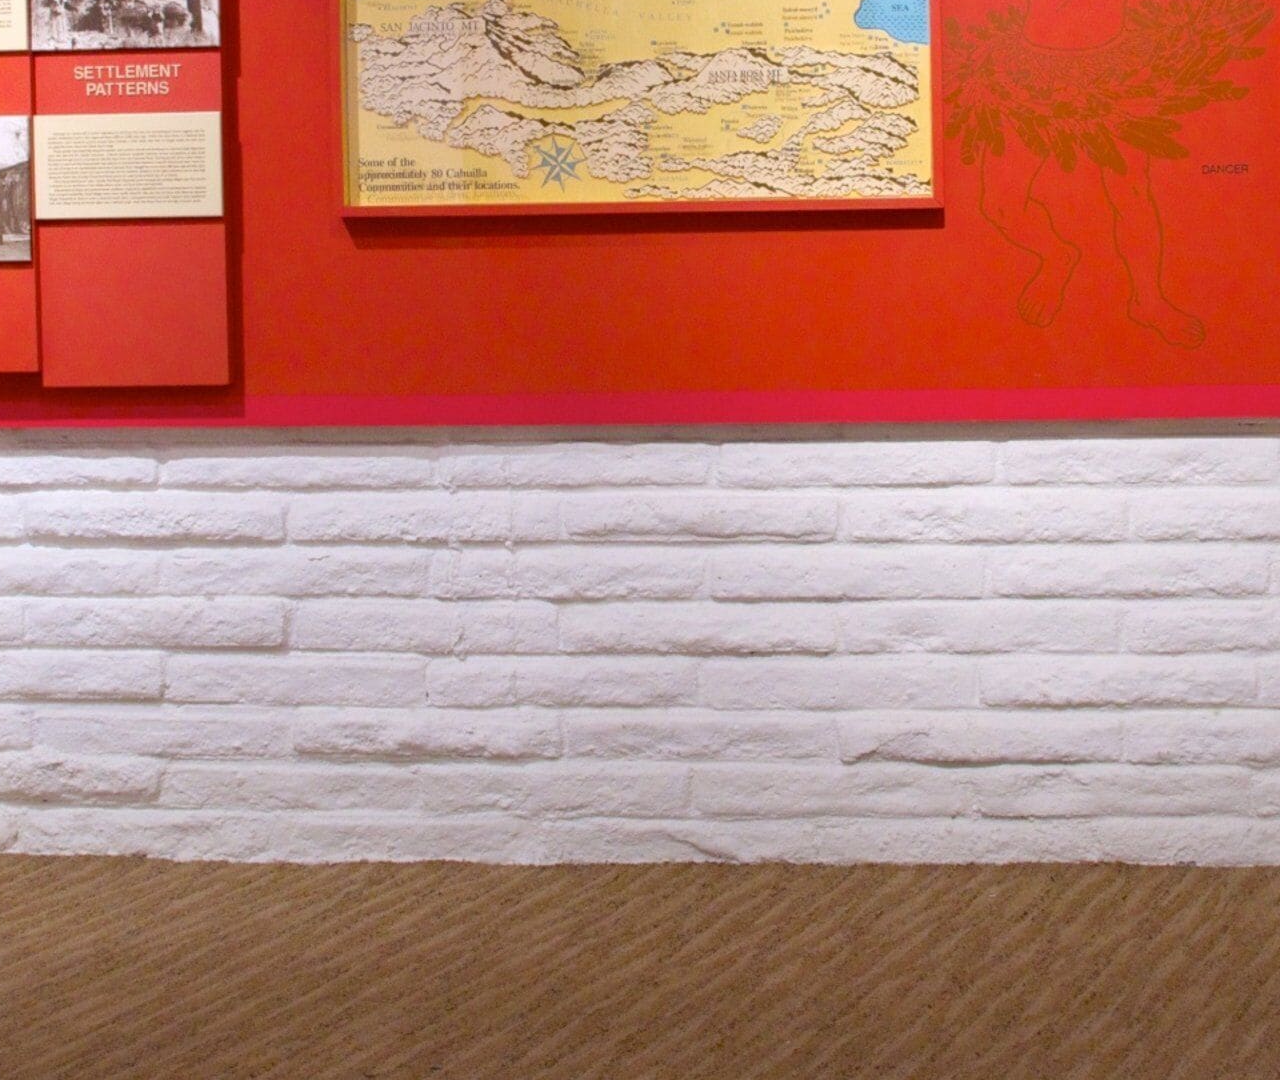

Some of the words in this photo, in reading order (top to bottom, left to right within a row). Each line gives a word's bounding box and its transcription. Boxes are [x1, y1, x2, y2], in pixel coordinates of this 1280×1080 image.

[891, 4, 909, 12] SEA
[73, 64, 181, 80] SETTLEMENT
[86, 81, 170, 97] PATTERNS
[358, 158, 384, 167] Some
[388, 158, 396, 166] of
[400, 157, 416, 166] the
[427, 182, 444, 191] and
[448, 181, 471, 190] their
